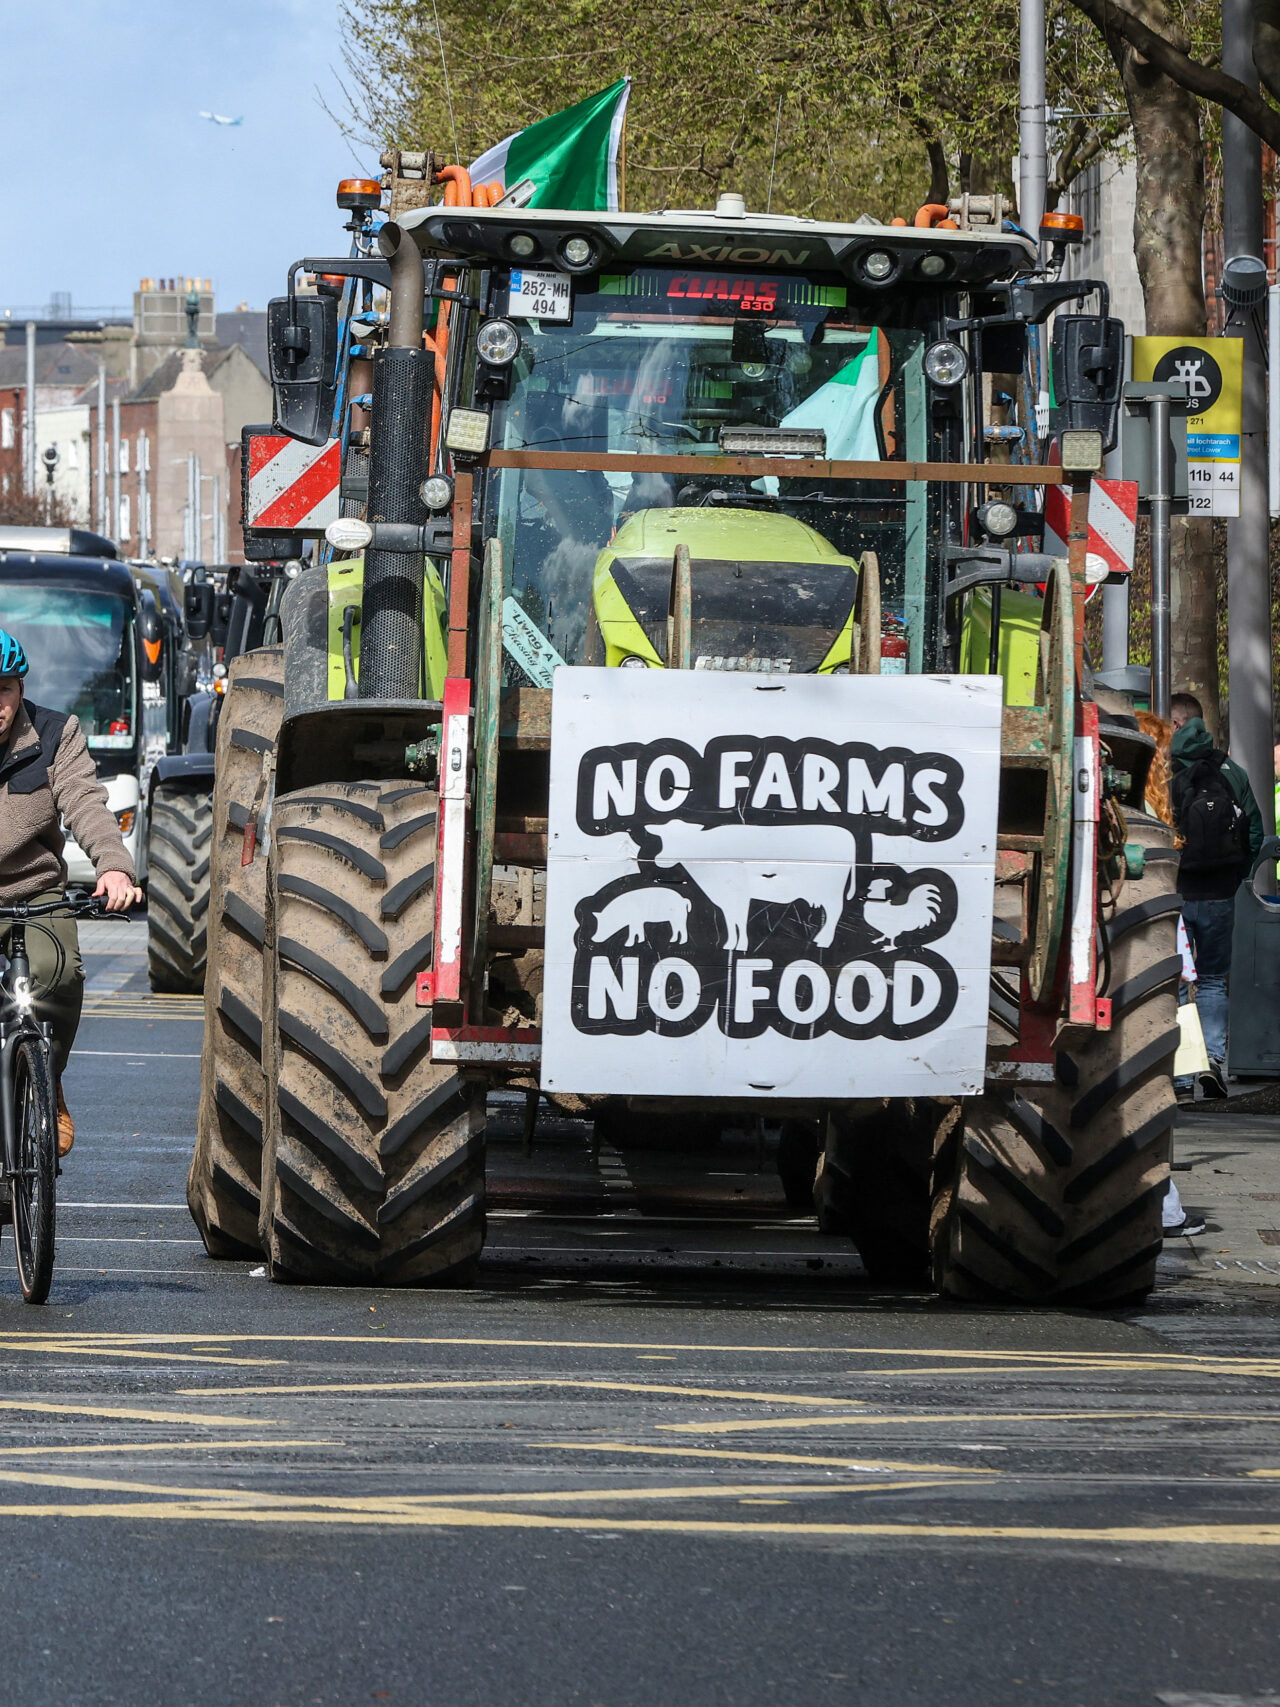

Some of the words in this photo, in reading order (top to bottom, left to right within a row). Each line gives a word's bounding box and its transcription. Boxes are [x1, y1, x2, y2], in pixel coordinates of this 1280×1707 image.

[644, 242, 811, 265] AXION
[522, 280, 569, 298] 252-MH
[666, 276, 779, 302] CLAAS
[532, 299, 556, 315] 494
[740, 301, 774, 312] 830
[1190, 417, 1204, 425] 271
[1189, 469, 1212, 482] 11b
[1219, 471, 1234, 482] 44
[1189, 498, 1211, 509] 122
[542, 653, 554, 662] A
[592, 753, 692, 820] NO
[718, 750, 950, 827] FARMS
[587, 954, 702, 1022] NO
[733, 957, 943, 1026] FOOD
